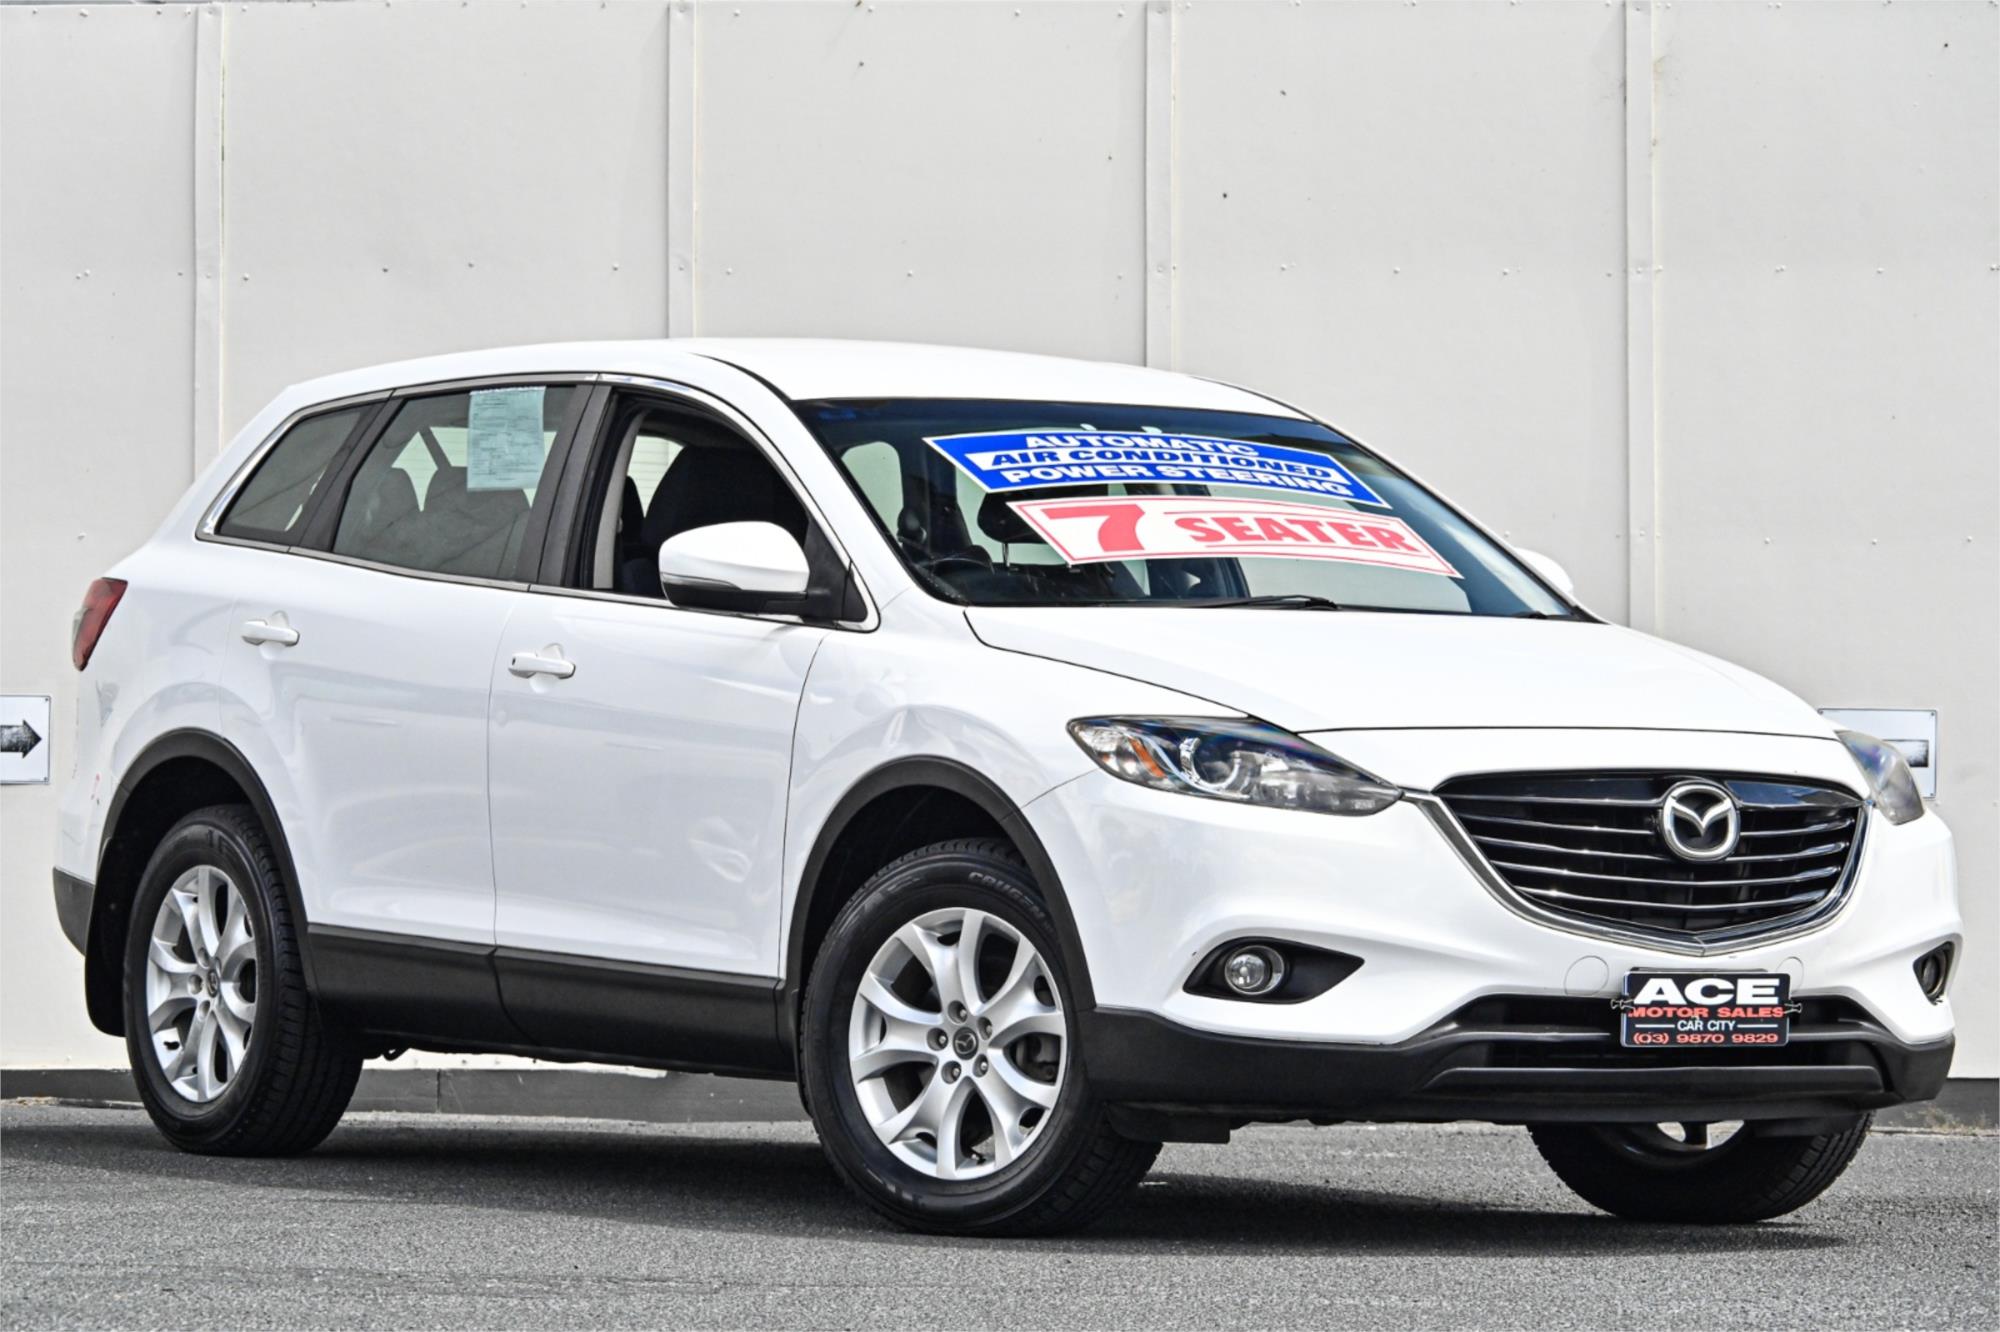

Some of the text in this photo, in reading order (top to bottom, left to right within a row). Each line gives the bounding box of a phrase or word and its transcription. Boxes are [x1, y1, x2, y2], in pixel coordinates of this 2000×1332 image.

[1025, 434, 1260, 457] AUTOMATIC
[991, 449, 1334, 479] AIR CONDITIONED
[1000, 464, 1354, 497] POWER STEERING
[1040, 503, 1420, 553] 7 SEATER
[1633, 977, 1781, 1006] ACE
[1628, 1006, 1784, 1018] MOTOR SALES
[1632, 1032, 1779, 1044] (03) 9870 9829
[1676, 1020, 1736, 1032] CAR CITY
